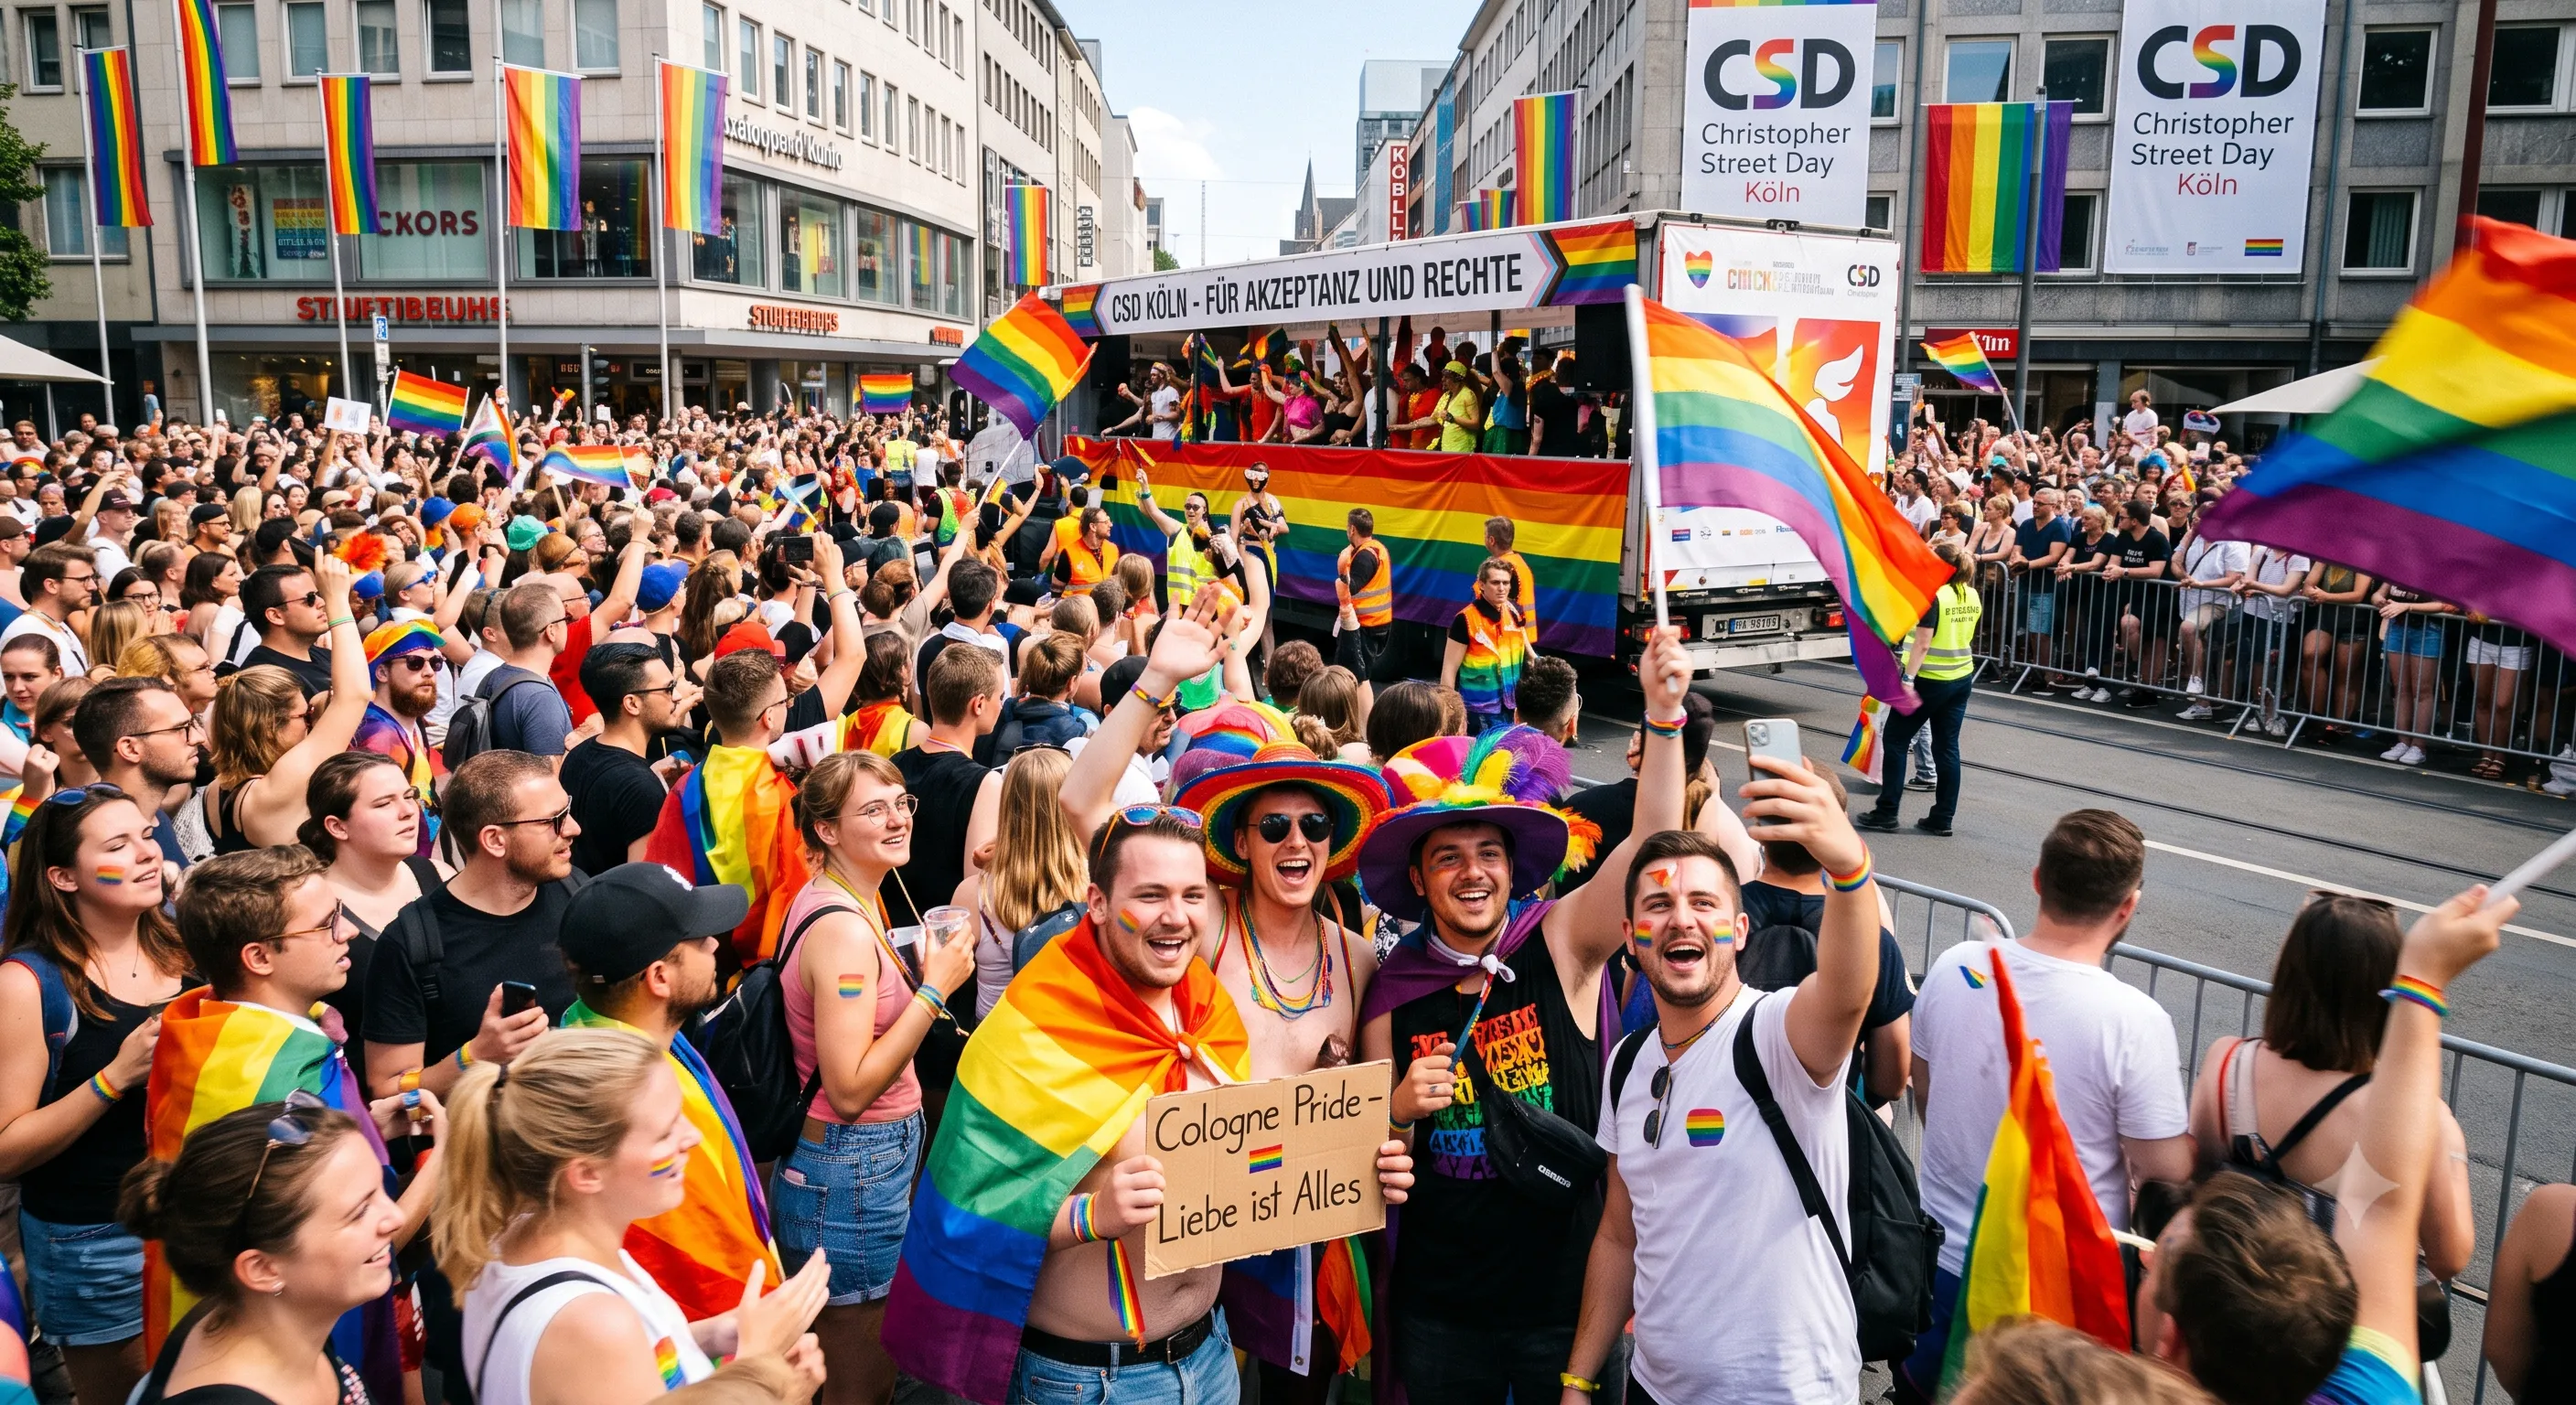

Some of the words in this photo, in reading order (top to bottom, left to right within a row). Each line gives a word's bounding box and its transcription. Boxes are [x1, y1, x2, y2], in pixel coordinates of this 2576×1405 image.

[1703, 38, 1856, 111] CSD
[2137, 24, 2302, 100] CSD
[1701, 122, 1852, 149] Christopher
[2133, 111, 2294, 139] Christopher
[1701, 152, 1777, 174] Street
[1786, 152, 1834, 178] Day
[2131, 143, 2213, 166] Street
[2222, 142, 2275, 171] Day
[1745, 181, 1800, 203] Köln
[2178, 172, 2238, 196] Köln
[1112, 293, 1141, 323] CSD
[1146, 283, 1187, 320] KÖLN
[1206, 276, 1239, 315] FÜR
[1245, 269, 1360, 313] AKZEPTANZ
[1368, 263, 1414, 303] UND
[1423, 252, 1523, 298] RECHTE
[1847, 263, 1881, 287] CSD
[1154, 1102, 1280, 1154] Cologne
[1294, 1079, 1361, 1126] Pride
[1158, 1194, 1238, 1244] Liebe
[1251, 1180, 1283, 1222] ist
[1293, 1168, 1361, 1216] Alles
